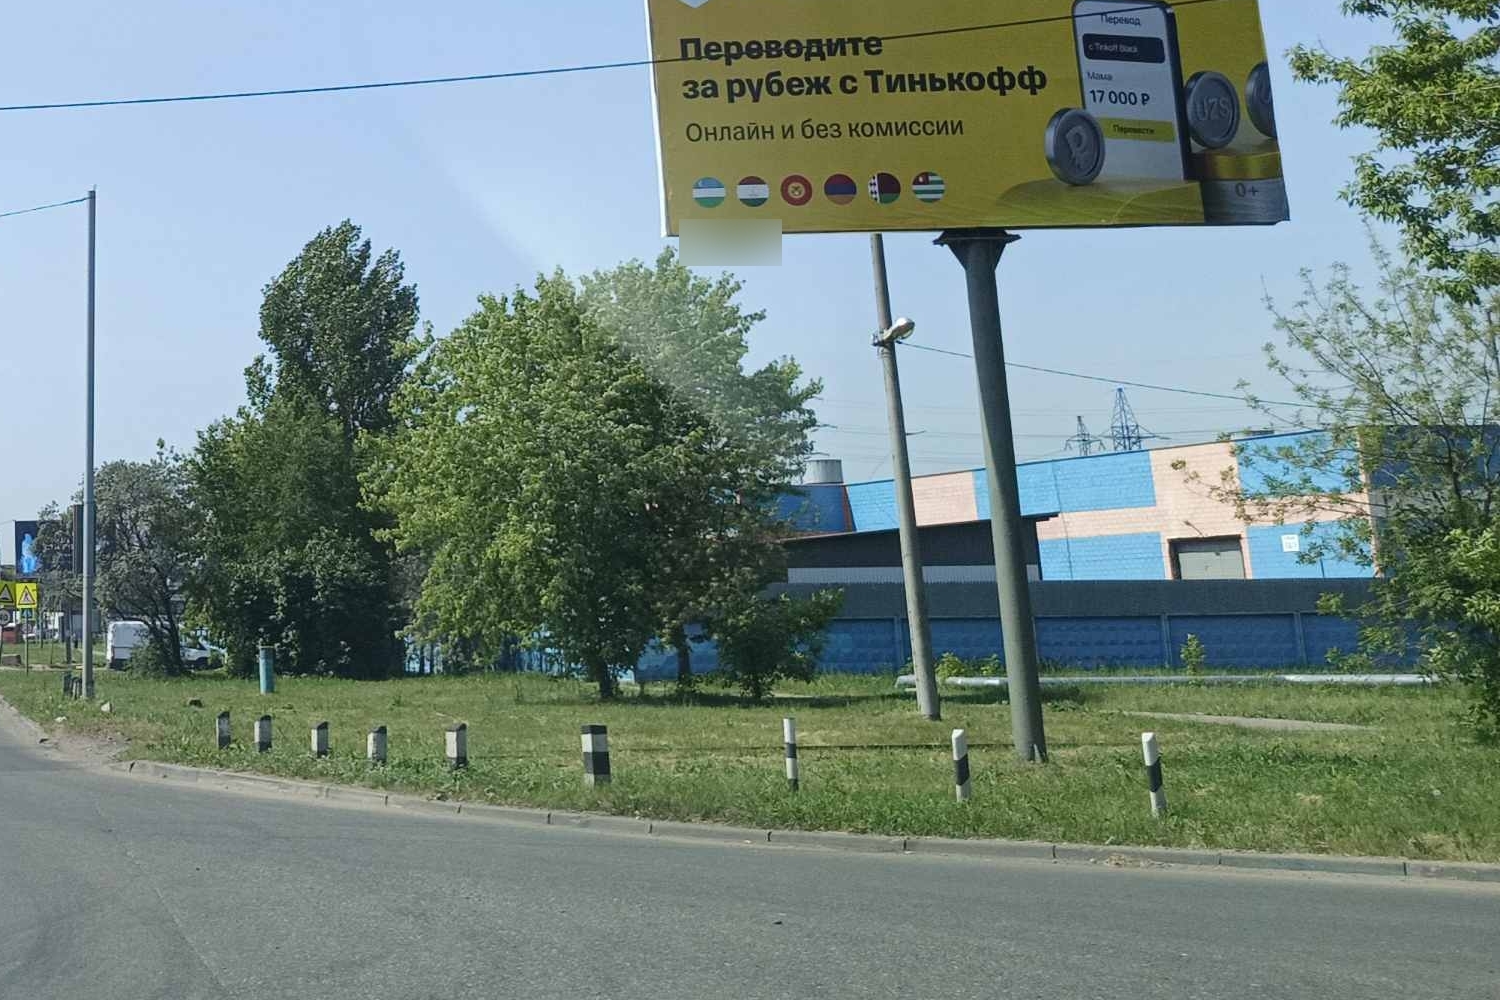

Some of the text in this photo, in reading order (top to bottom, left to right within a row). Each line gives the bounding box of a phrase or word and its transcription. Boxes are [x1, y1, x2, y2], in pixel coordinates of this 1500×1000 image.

[1100, 13, 1142, 27] Перевод
[680, 35, 884, 66] Переводите
[682, 66, 1047, 103] за рубеж с Тинькофф
[1087, 71, 1113, 82] Мама
[1090, 89, 1106, 104] 17
[1108, 89, 1138, 106] 000
[685, 118, 965, 143] Онлайн и без комиссии
[1112, 123, 1155, 135] Перевести
[1234, 182, 1260, 199] 0+
